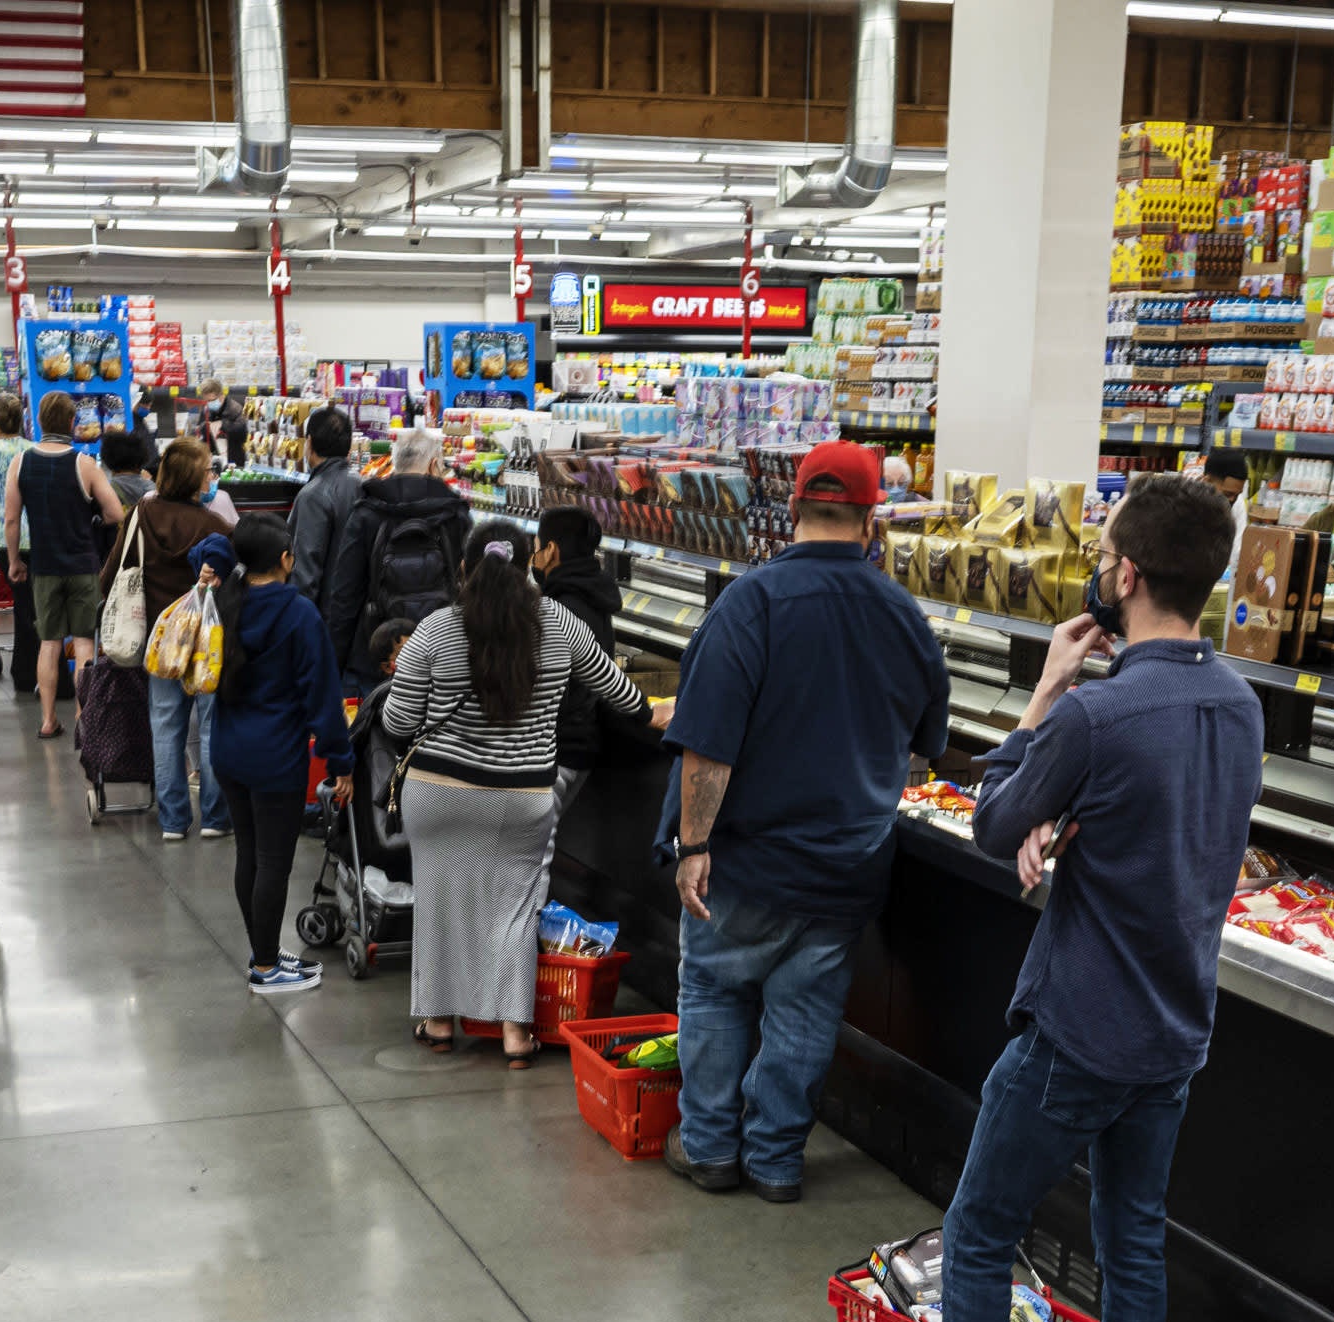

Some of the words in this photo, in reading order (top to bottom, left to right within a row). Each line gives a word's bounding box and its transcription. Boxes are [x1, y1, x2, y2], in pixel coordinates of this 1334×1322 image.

[7, 257, 25, 287] 3
[271, 260, 291, 291] 4
[514, 264, 532, 294] 5
[742, 269, 760, 295] 6
[651, 297, 709, 317] CRAFT
[1244, 324, 1296, 336] POWERADE
